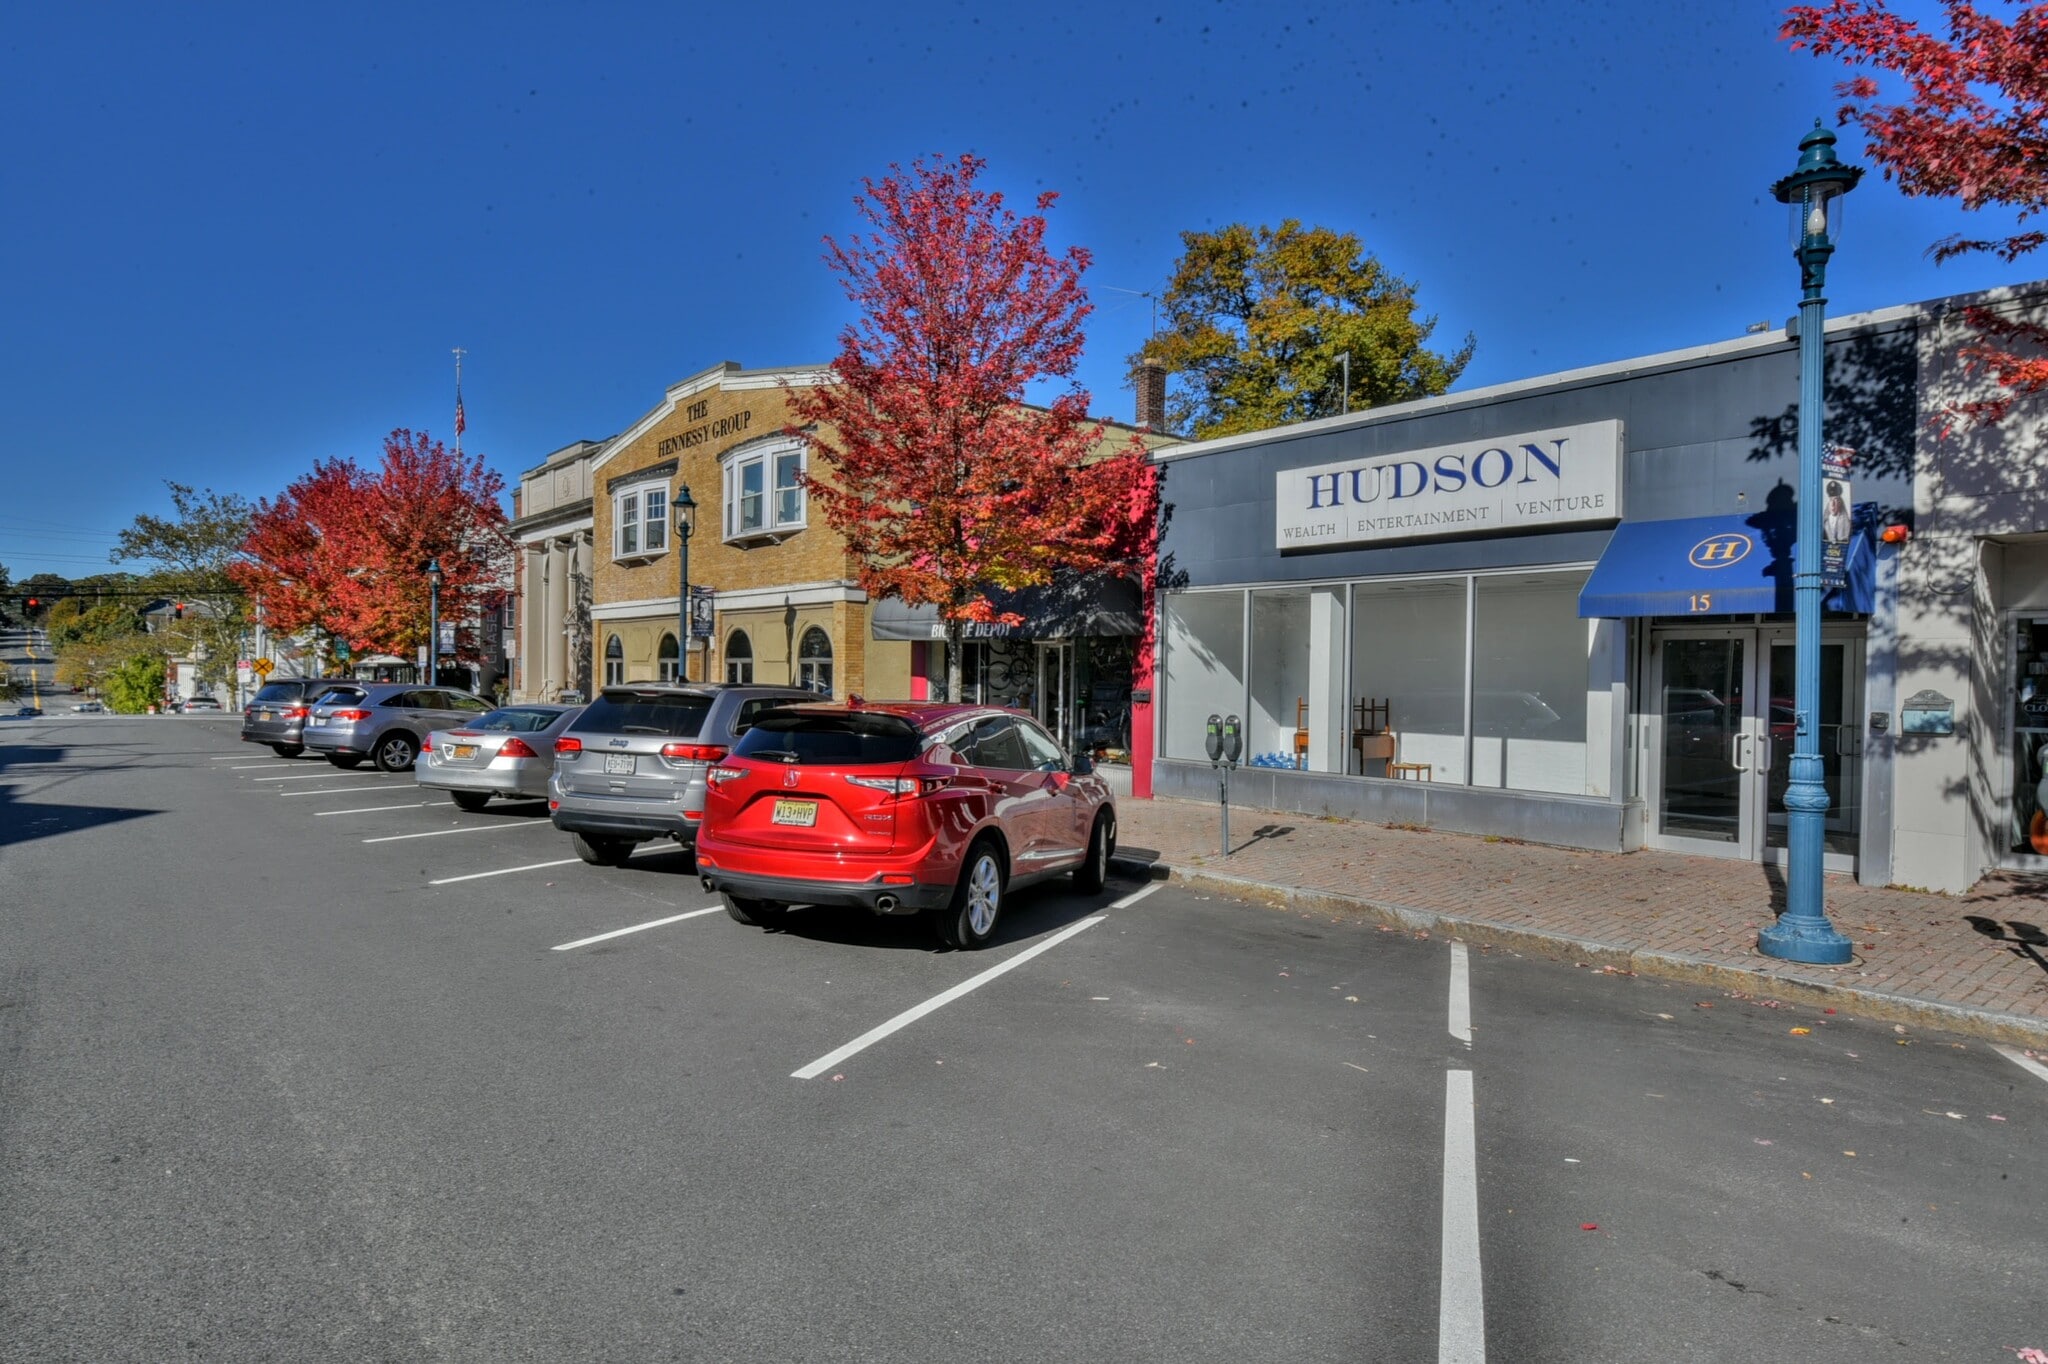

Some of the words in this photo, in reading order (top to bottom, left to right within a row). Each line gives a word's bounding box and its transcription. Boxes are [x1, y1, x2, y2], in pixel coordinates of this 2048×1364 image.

[687, 399, 708, 423] THE
[658, 425, 710, 458] HENNESSY
[712, 410, 751, 439] GROUP
[1306, 437, 1570, 510] HUDSON
[1284, 522, 1336, 539] WEALTH
[1357, 506, 1490, 532] ENTERTAINMENT
[1516, 494, 1605, 516] VENTURE
[1697, 541, 1742, 561] H
[1689, 594, 1711, 612] 15
[487, 614, 497, 664] CHASE
[975, 622, 1011, 638] DEPOT
[2024, 704, 2048, 712] CLO
